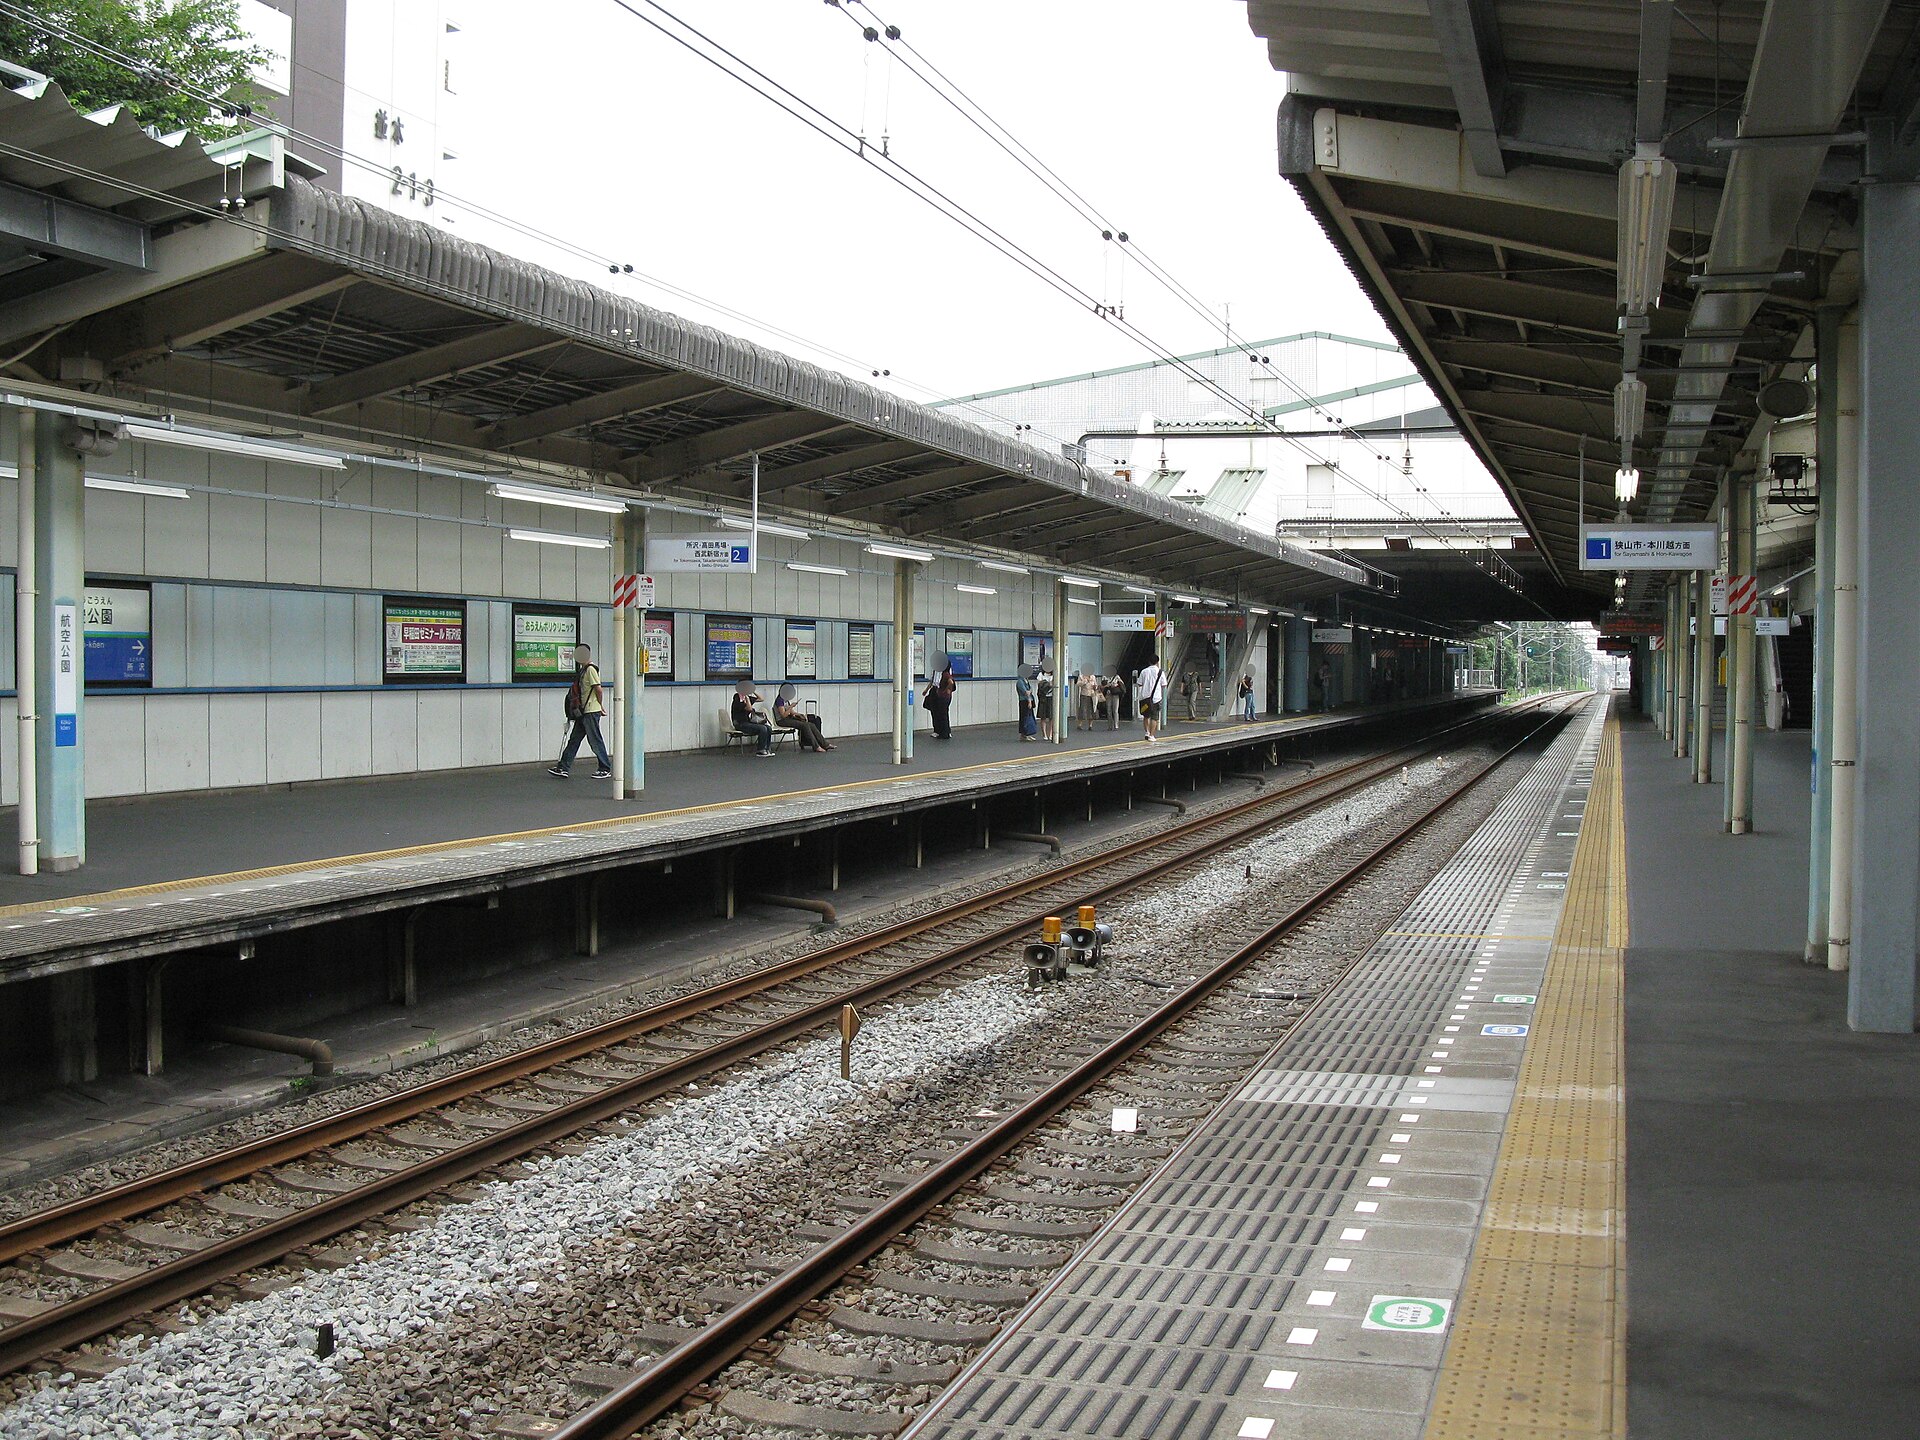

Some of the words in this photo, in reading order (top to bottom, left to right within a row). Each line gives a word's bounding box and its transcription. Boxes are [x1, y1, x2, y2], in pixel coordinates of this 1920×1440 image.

[391, 165, 434, 207] 2-1-3
[1601, 542, 1606, 557] 1
[1614, 541, 1691, 550] 狭山市・本川越方面
[733, 549, 740, 561] 2
[84, 596, 113, 605] こうえん
[525, 621, 575, 633] おうえんポリクリニック
[60, 613, 71, 673] 航空公園
